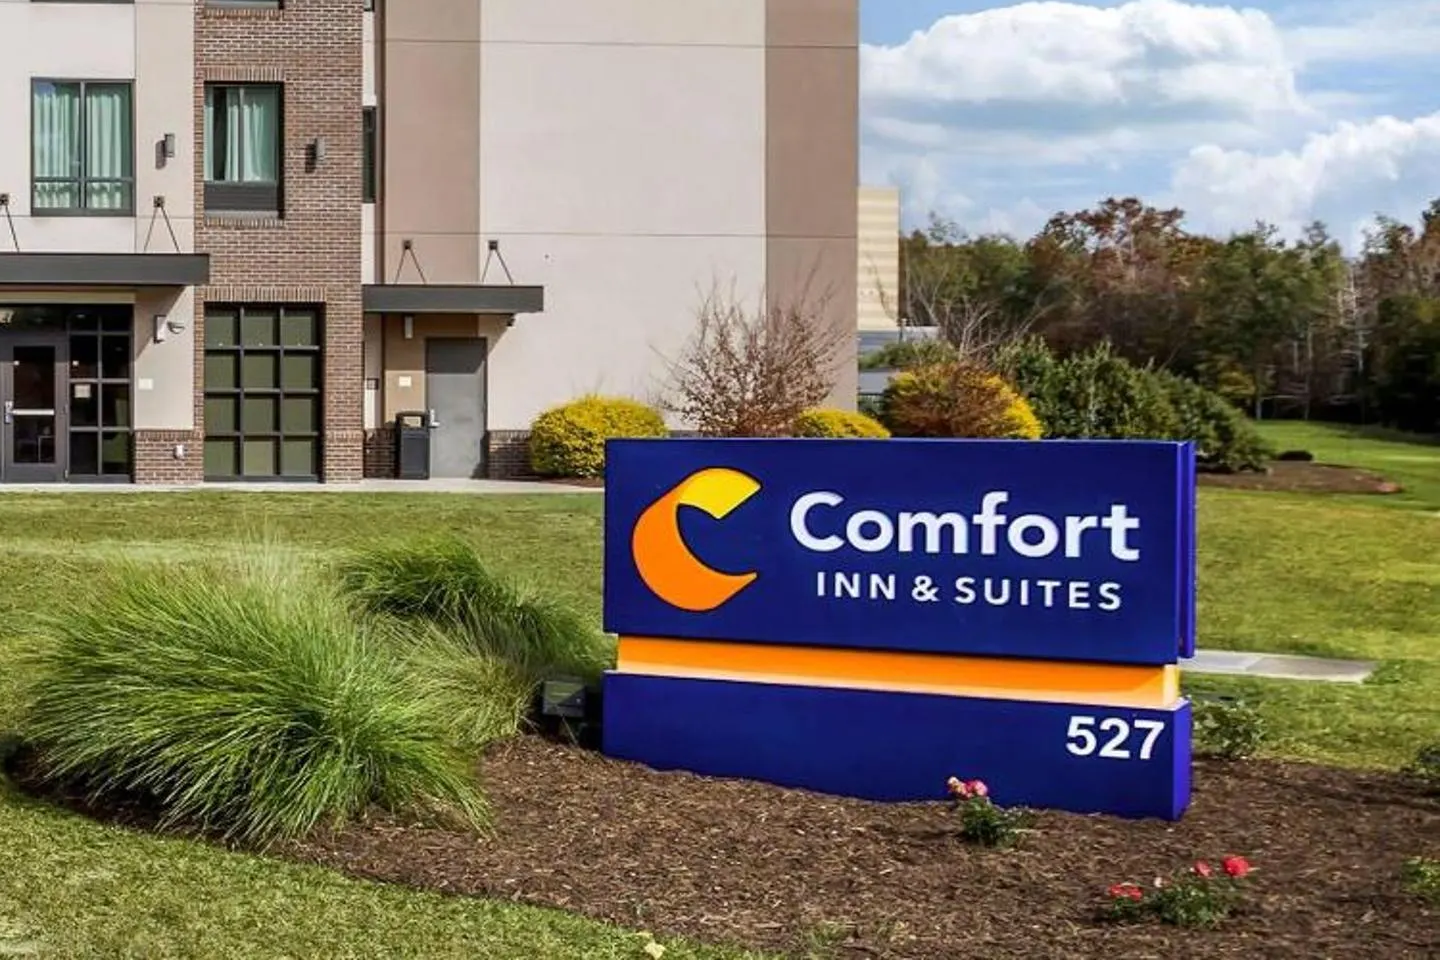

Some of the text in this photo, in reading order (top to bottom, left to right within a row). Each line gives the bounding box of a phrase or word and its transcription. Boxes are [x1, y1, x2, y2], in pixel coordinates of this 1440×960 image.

[790, 491, 1140, 561] Comfort
[817, 572, 1122, 610] INN & SUITES
[1066, 715, 1165, 760] 527
